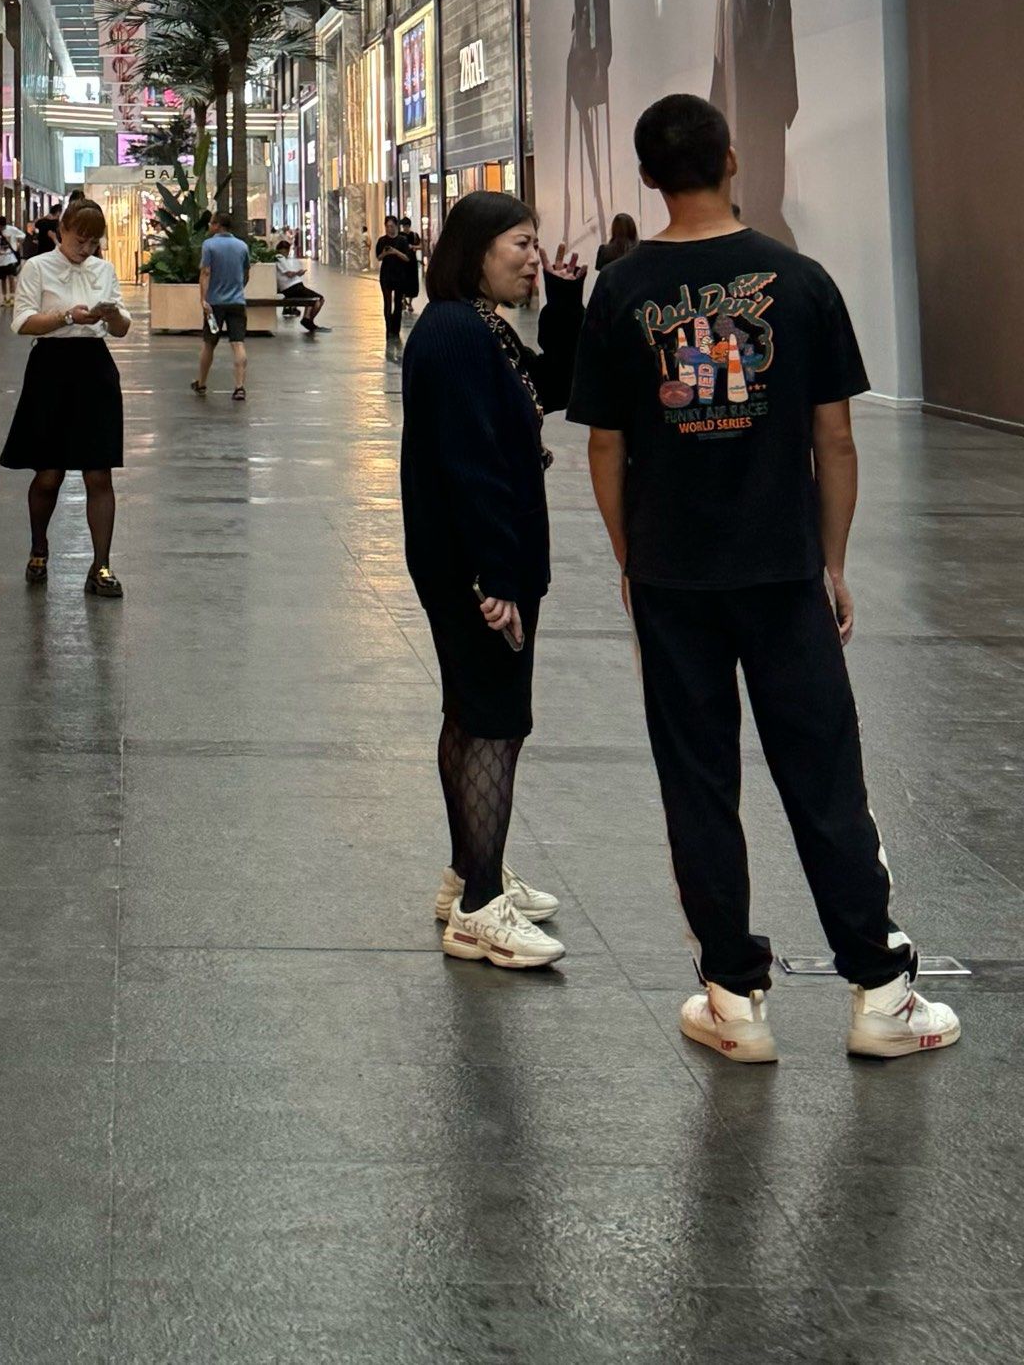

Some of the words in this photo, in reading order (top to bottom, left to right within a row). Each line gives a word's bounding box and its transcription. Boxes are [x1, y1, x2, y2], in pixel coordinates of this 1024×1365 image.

[144, 169, 195, 179] BAL
[678, 419, 715, 434] WORLD
[717, 416, 753, 430] SERIES
[463, 920, 512, 944] GUCCI
